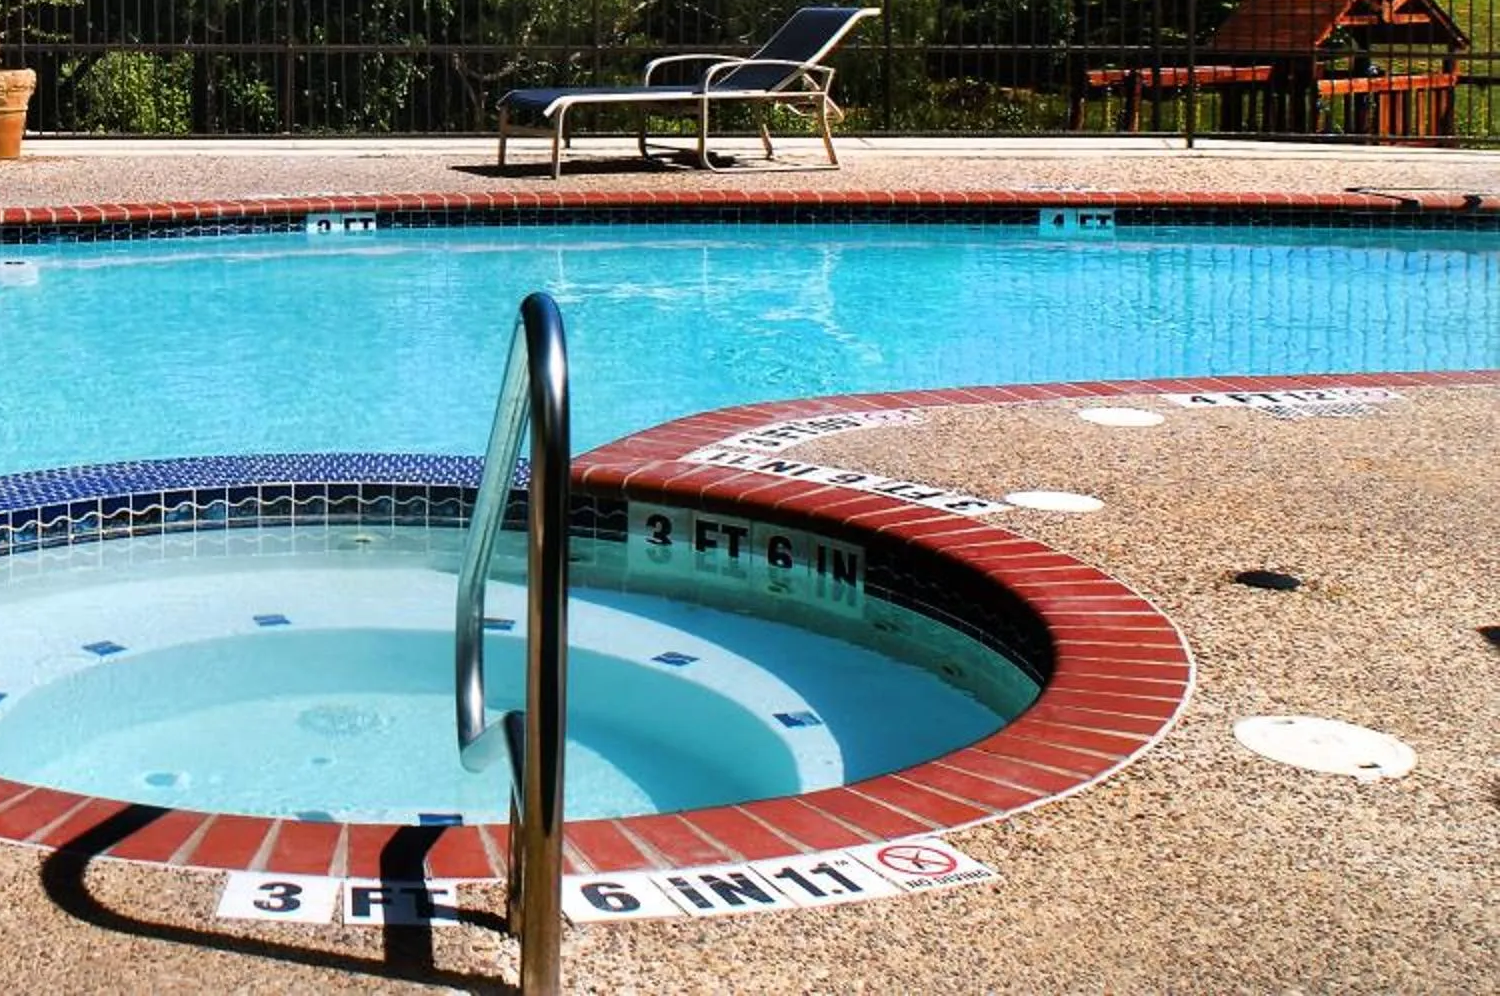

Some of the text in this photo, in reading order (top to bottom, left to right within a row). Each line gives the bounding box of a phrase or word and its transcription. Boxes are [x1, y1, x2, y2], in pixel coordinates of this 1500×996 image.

[758, 460, 817, 477] IN
[827, 472, 867, 484] 6
[645, 513, 858, 589] 3 FT 6 IN
[252, 884, 304, 913] 3
[351, 886, 449, 919] FT
[580, 881, 642, 913] 6
[667, 872, 777, 909] IN
